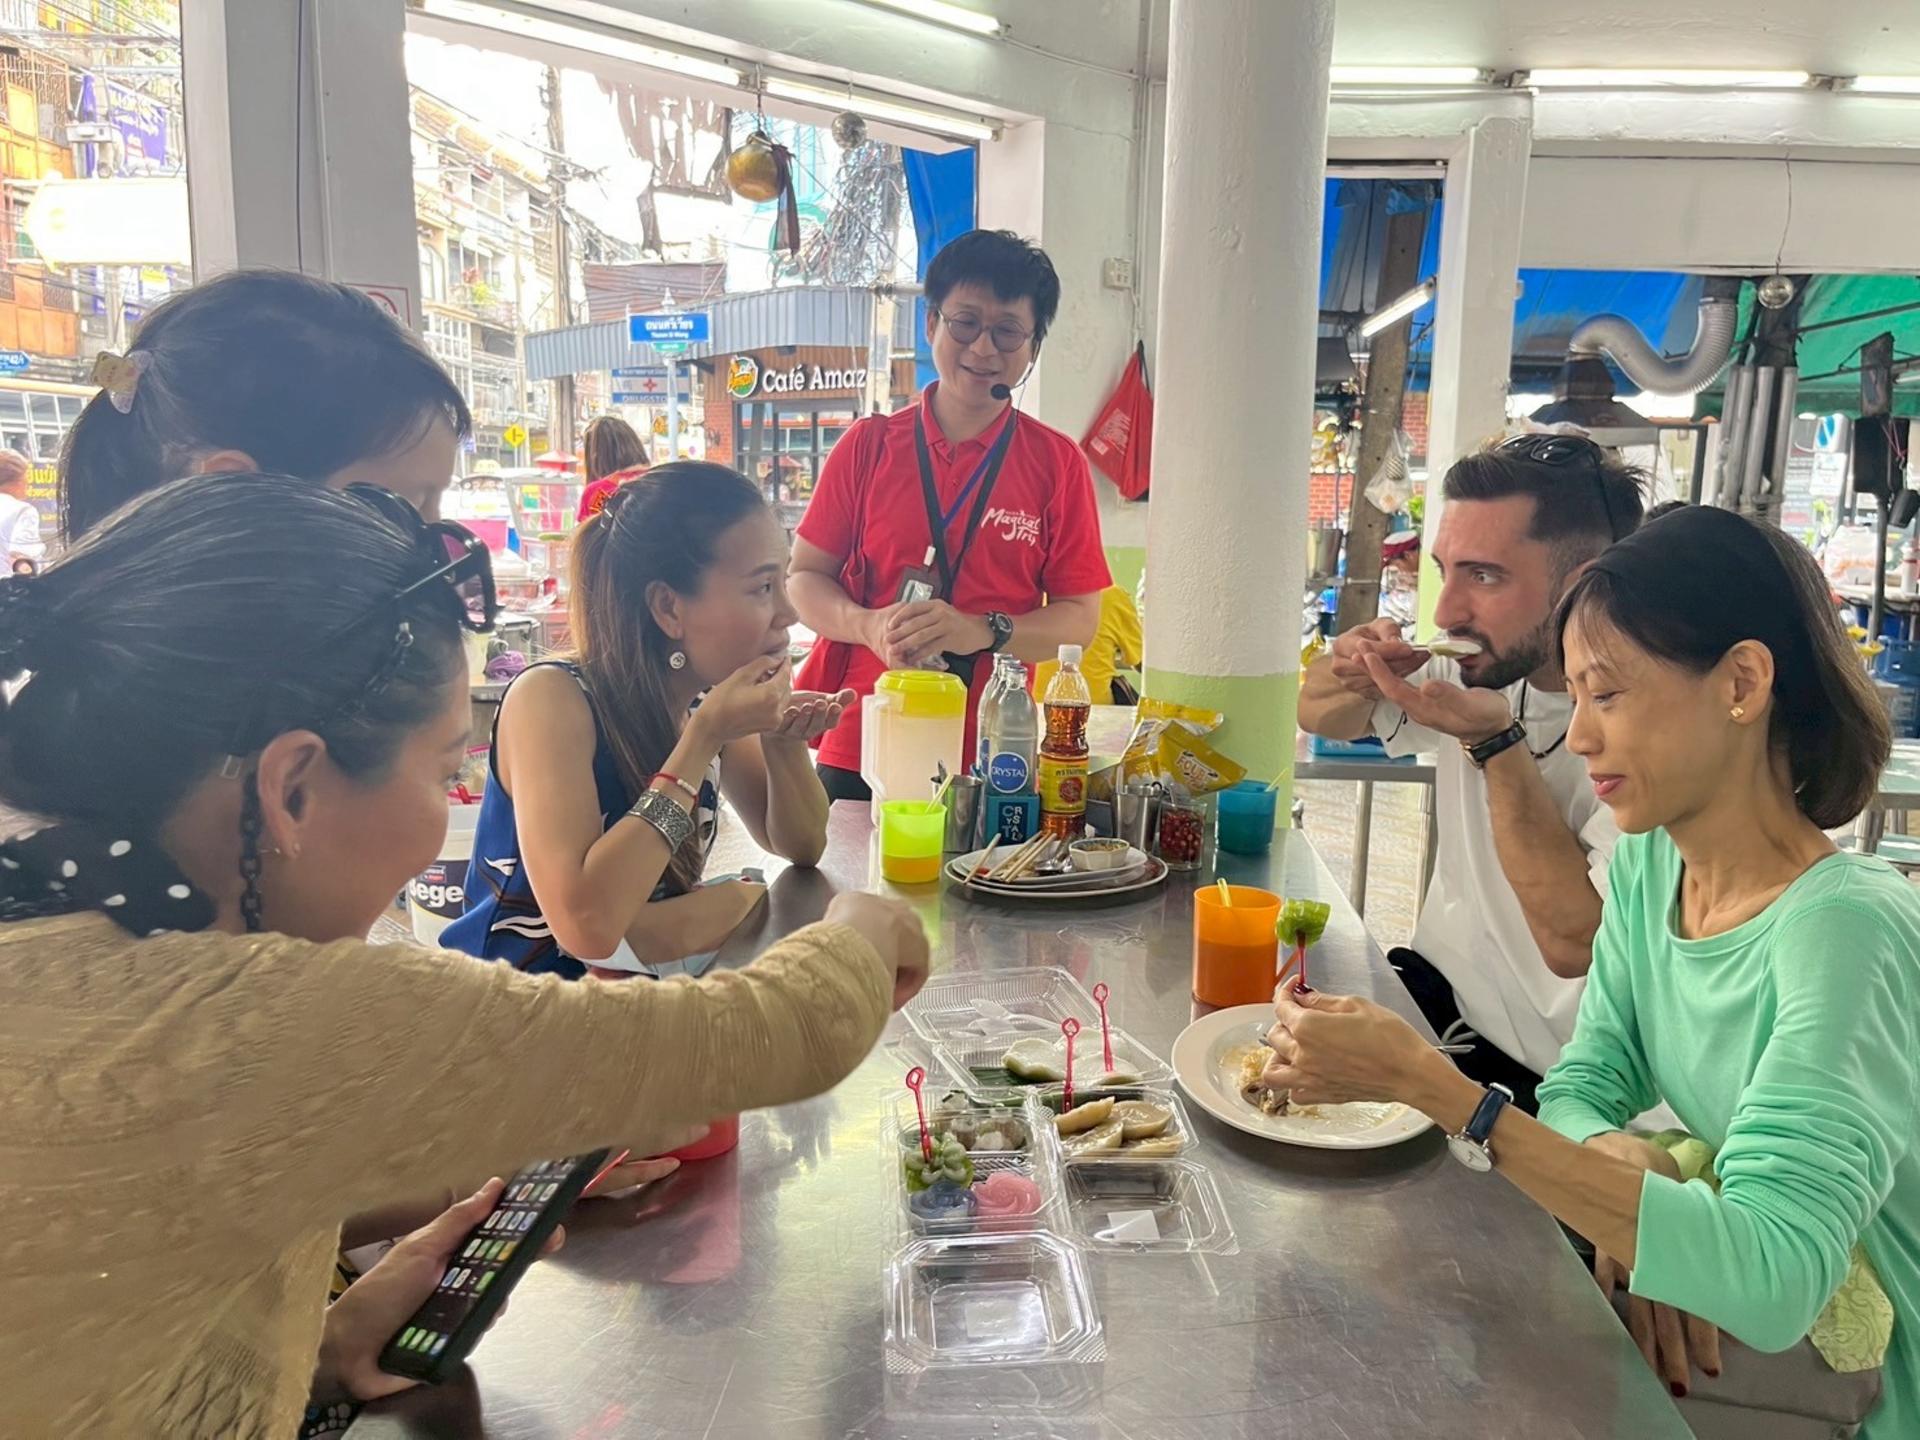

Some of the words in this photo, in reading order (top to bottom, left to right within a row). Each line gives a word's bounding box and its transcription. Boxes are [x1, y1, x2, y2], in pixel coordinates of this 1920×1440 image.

[762, 364, 806, 393] Café
[809, 365, 867, 391] Amaz
[623, 394, 668, 402] DRUGSTO
[991, 765, 1026, 778] CRYSTAL
[409, 878, 464, 908] ege
